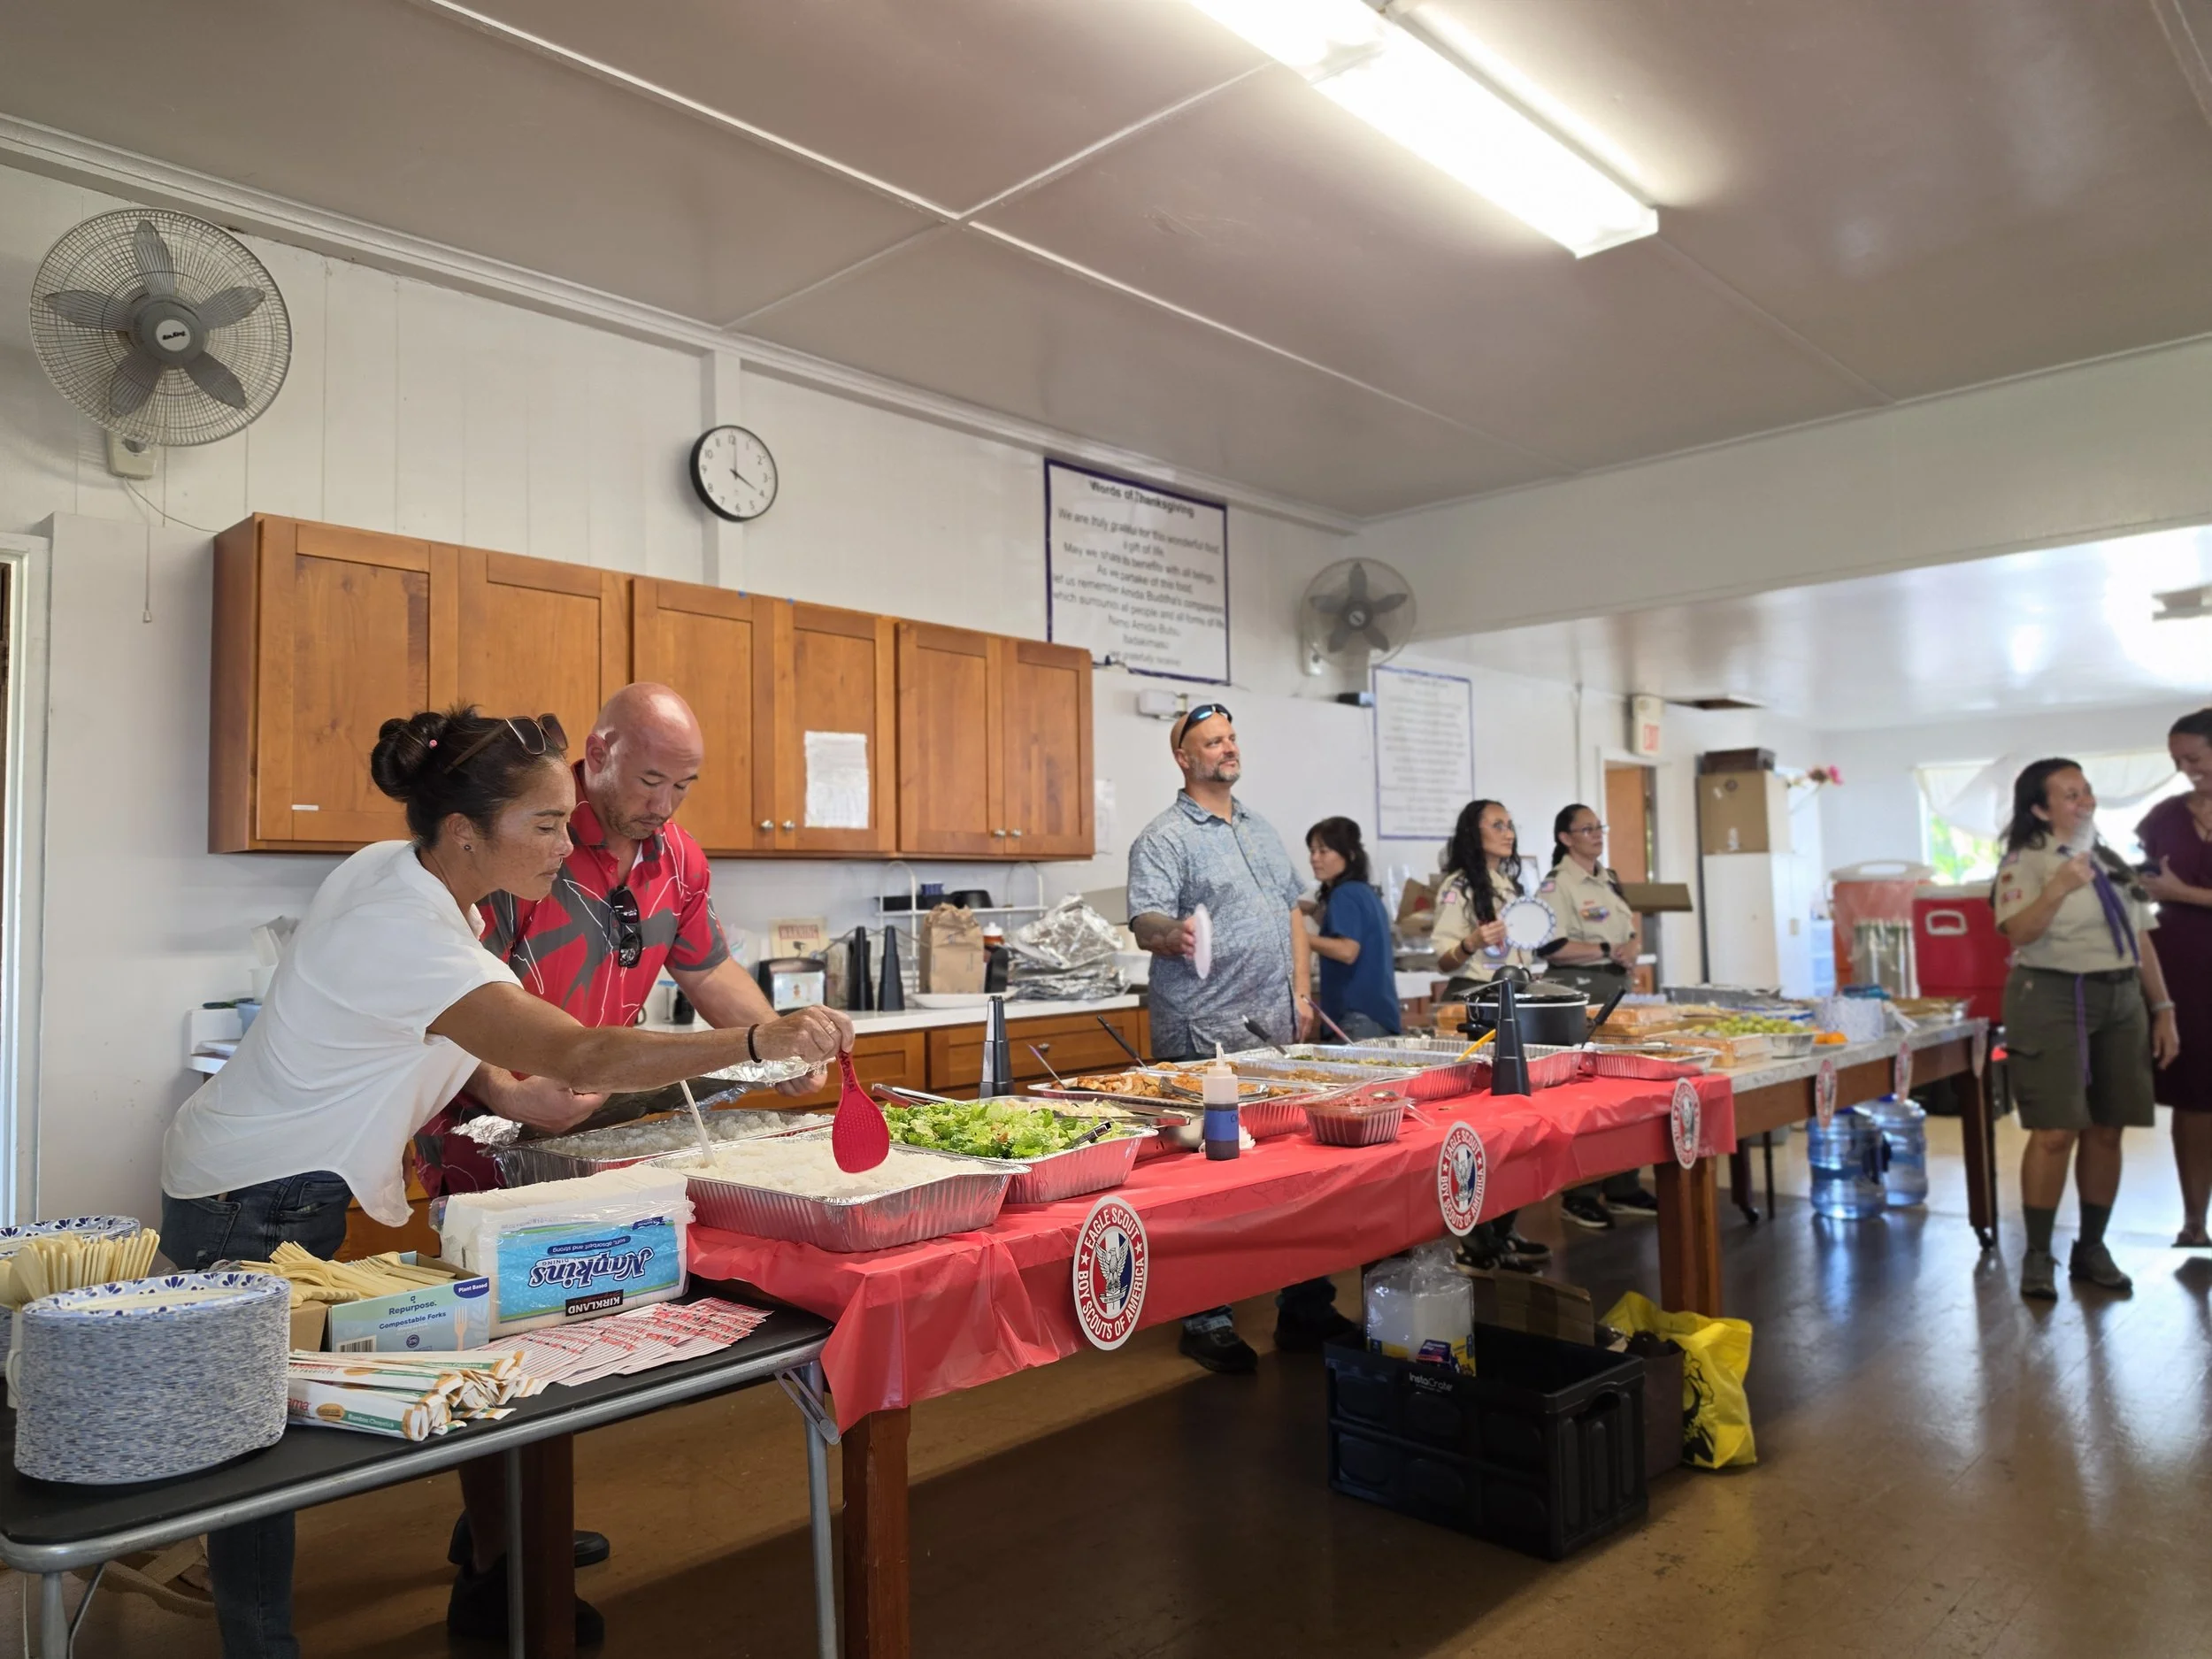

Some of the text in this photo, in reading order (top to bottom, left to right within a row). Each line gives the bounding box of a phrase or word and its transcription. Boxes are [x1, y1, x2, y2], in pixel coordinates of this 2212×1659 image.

[728, 434, 736, 445] 12
[704, 449, 713, 459] 10
[757, 455, 763, 465] 2
[701, 464, 707, 474] 9
[763, 472, 769, 483] 3
[707, 482, 714, 493] 8
[759, 489, 765, 498] 4
[1089, 480, 1194, 518] Words of Thanksgiving
[720, 495, 726, 505] 7
[749, 500, 755, 511] 5
[734, 503, 741, 512] 6
[1058, 508, 1072, 521] We
[1074, 513, 1089, 525] are
[1091, 514, 1107, 531] truly
[1167, 535, 1203, 551] wonderful
[1142, 544, 1151, 555] of
[1064, 541, 1083, 557] May
[1086, 549, 1098, 558] we
[1131, 557, 1164, 573] benefits
[1165, 565, 1181, 575] with
[1097, 563, 1108, 576] As
[1151, 576, 1160, 588] of
[1065, 576, 1076, 588] us
[1078, 579, 1119, 595] remember
[1053, 590, 1077, 603] which
[1131, 605, 1158, 619] people
[1444, 1130, 1481, 1160] EAGLE SCOUT
[1440, 1168, 1485, 1229] BOY SCOUTS OF AMERICA
[1084, 1207, 1141, 1249] EAGLE SCOUT
[552, 1245, 572, 1254] strong
[571, 1243, 584, 1252] and
[584, 1240, 613, 1251] absorbent
[528, 1247, 655, 1288] Napkins
[458, 1282, 488, 1294] Plant Based
[1078, 1256, 1145, 1340] BOY SCOUTS OF AMERICA
[567, 1296, 620, 1314] KIRKLAND
[379, 1315, 426, 1330] Compostable
[427, 1311, 447, 1321] Forks
